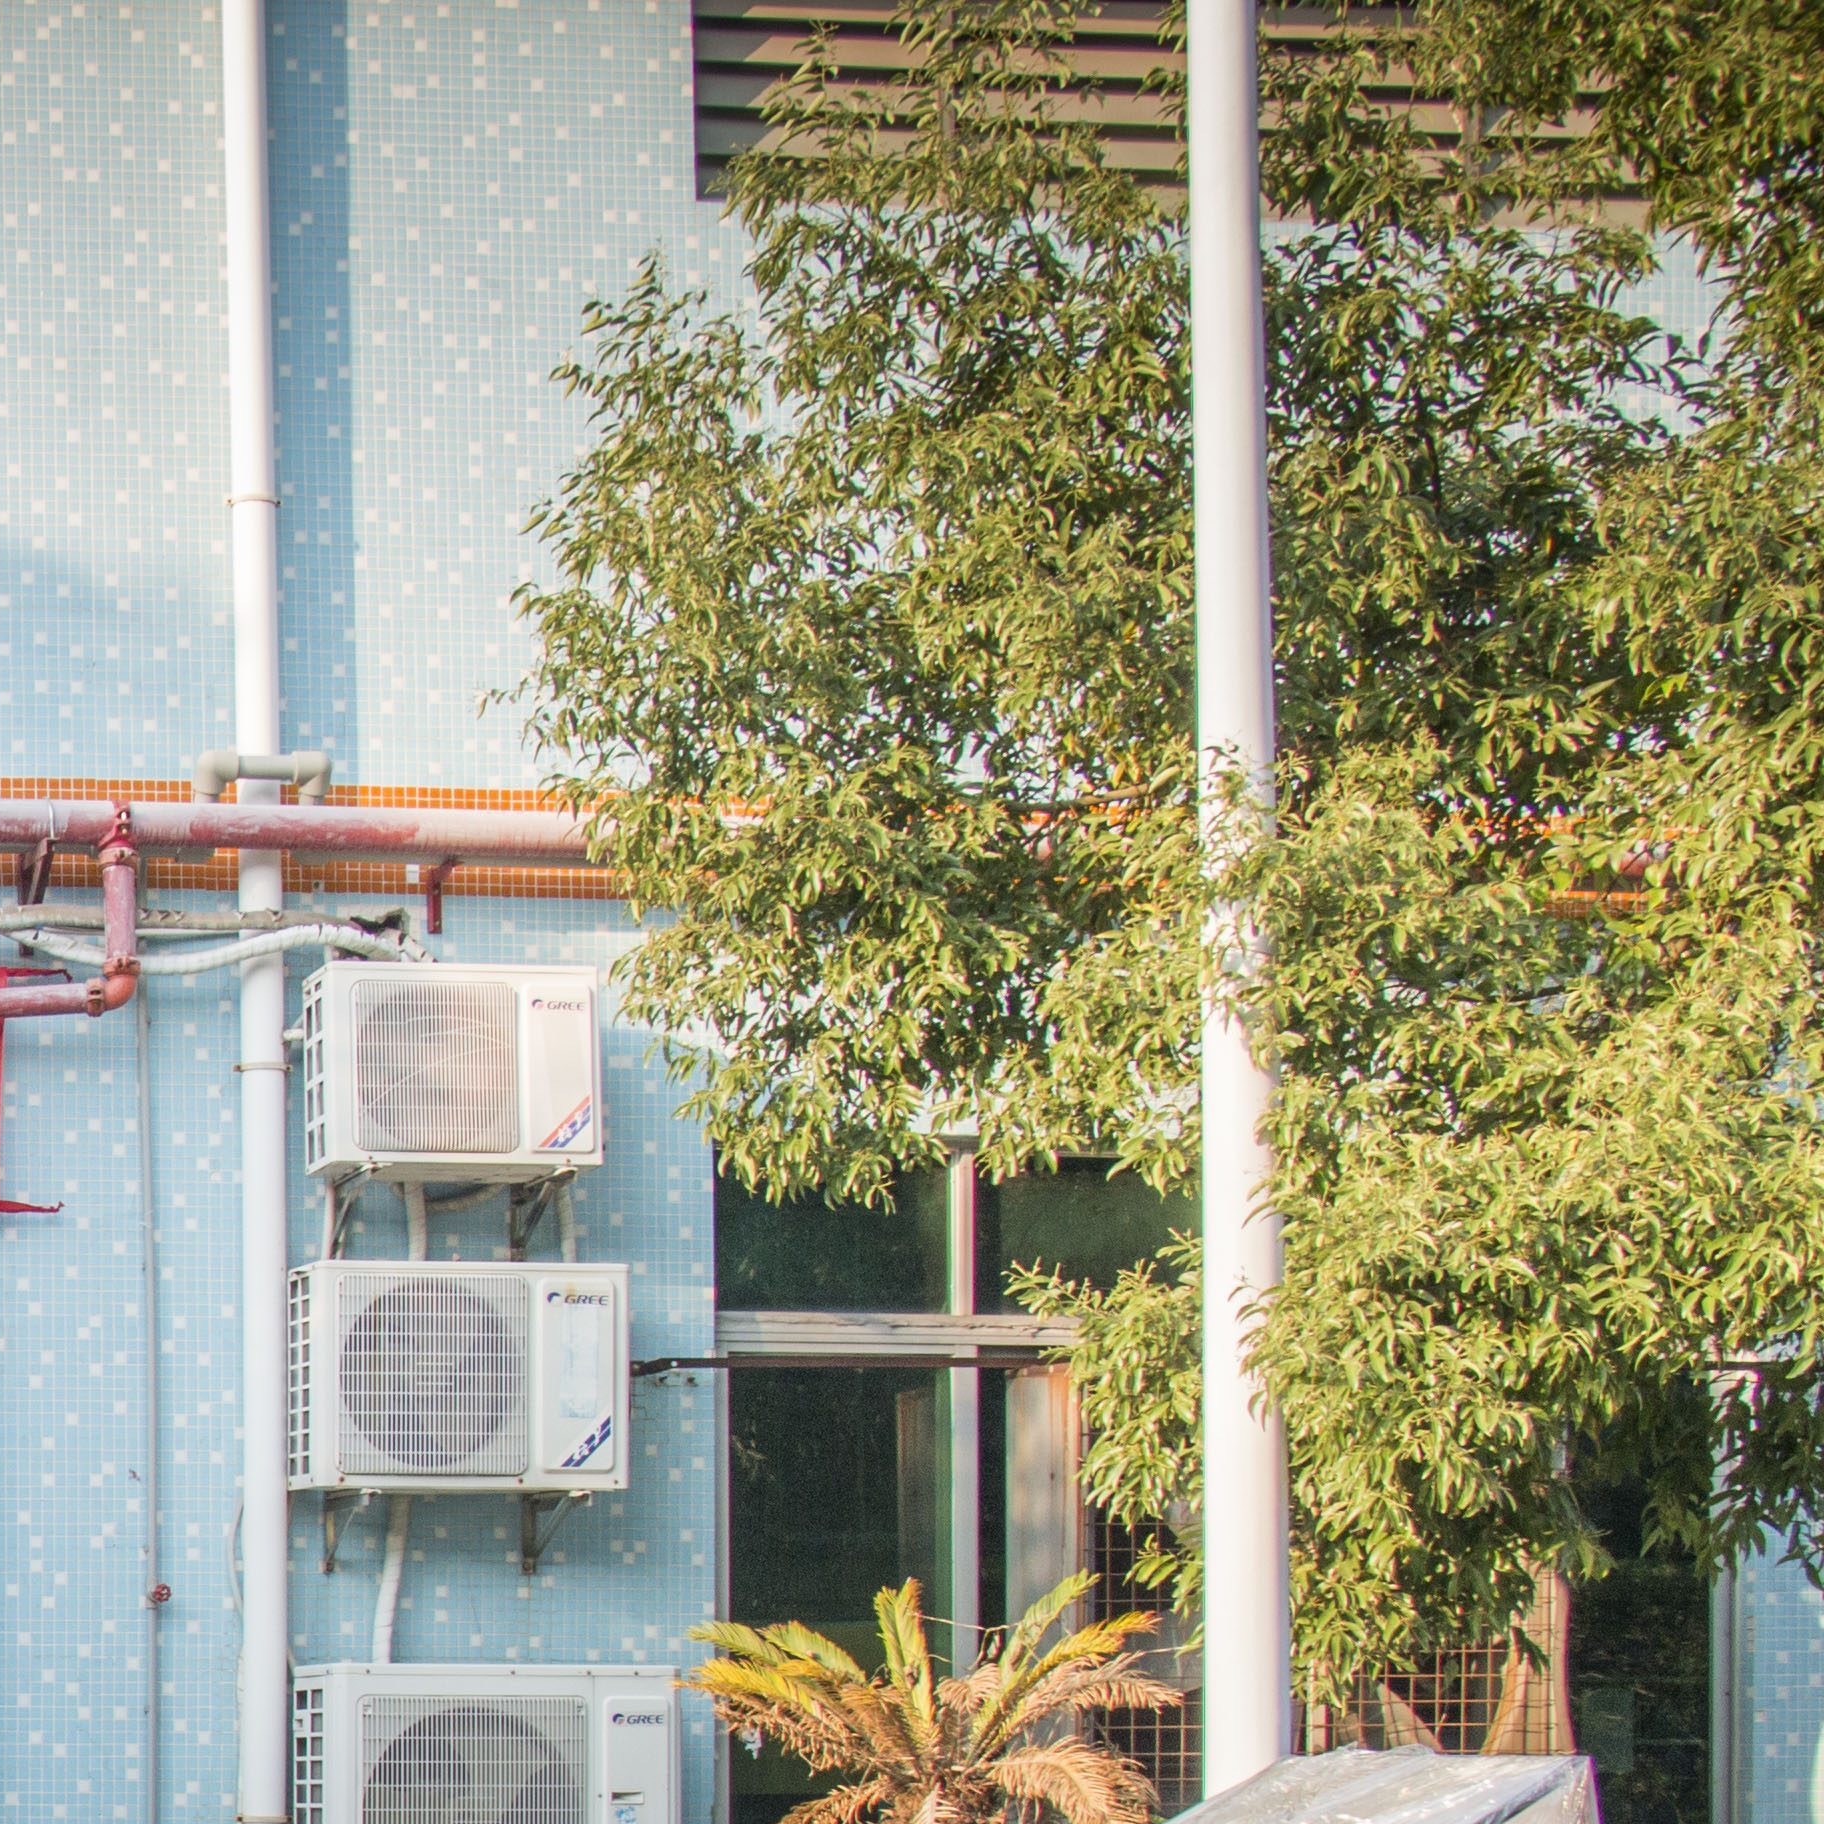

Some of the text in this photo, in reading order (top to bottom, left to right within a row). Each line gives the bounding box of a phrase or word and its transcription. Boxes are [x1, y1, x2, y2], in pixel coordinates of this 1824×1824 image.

[547, 1000, 585, 1011] GREE
[564, 1295, 609, 1306] GREE
[626, 1714, 664, 1725] GREE
